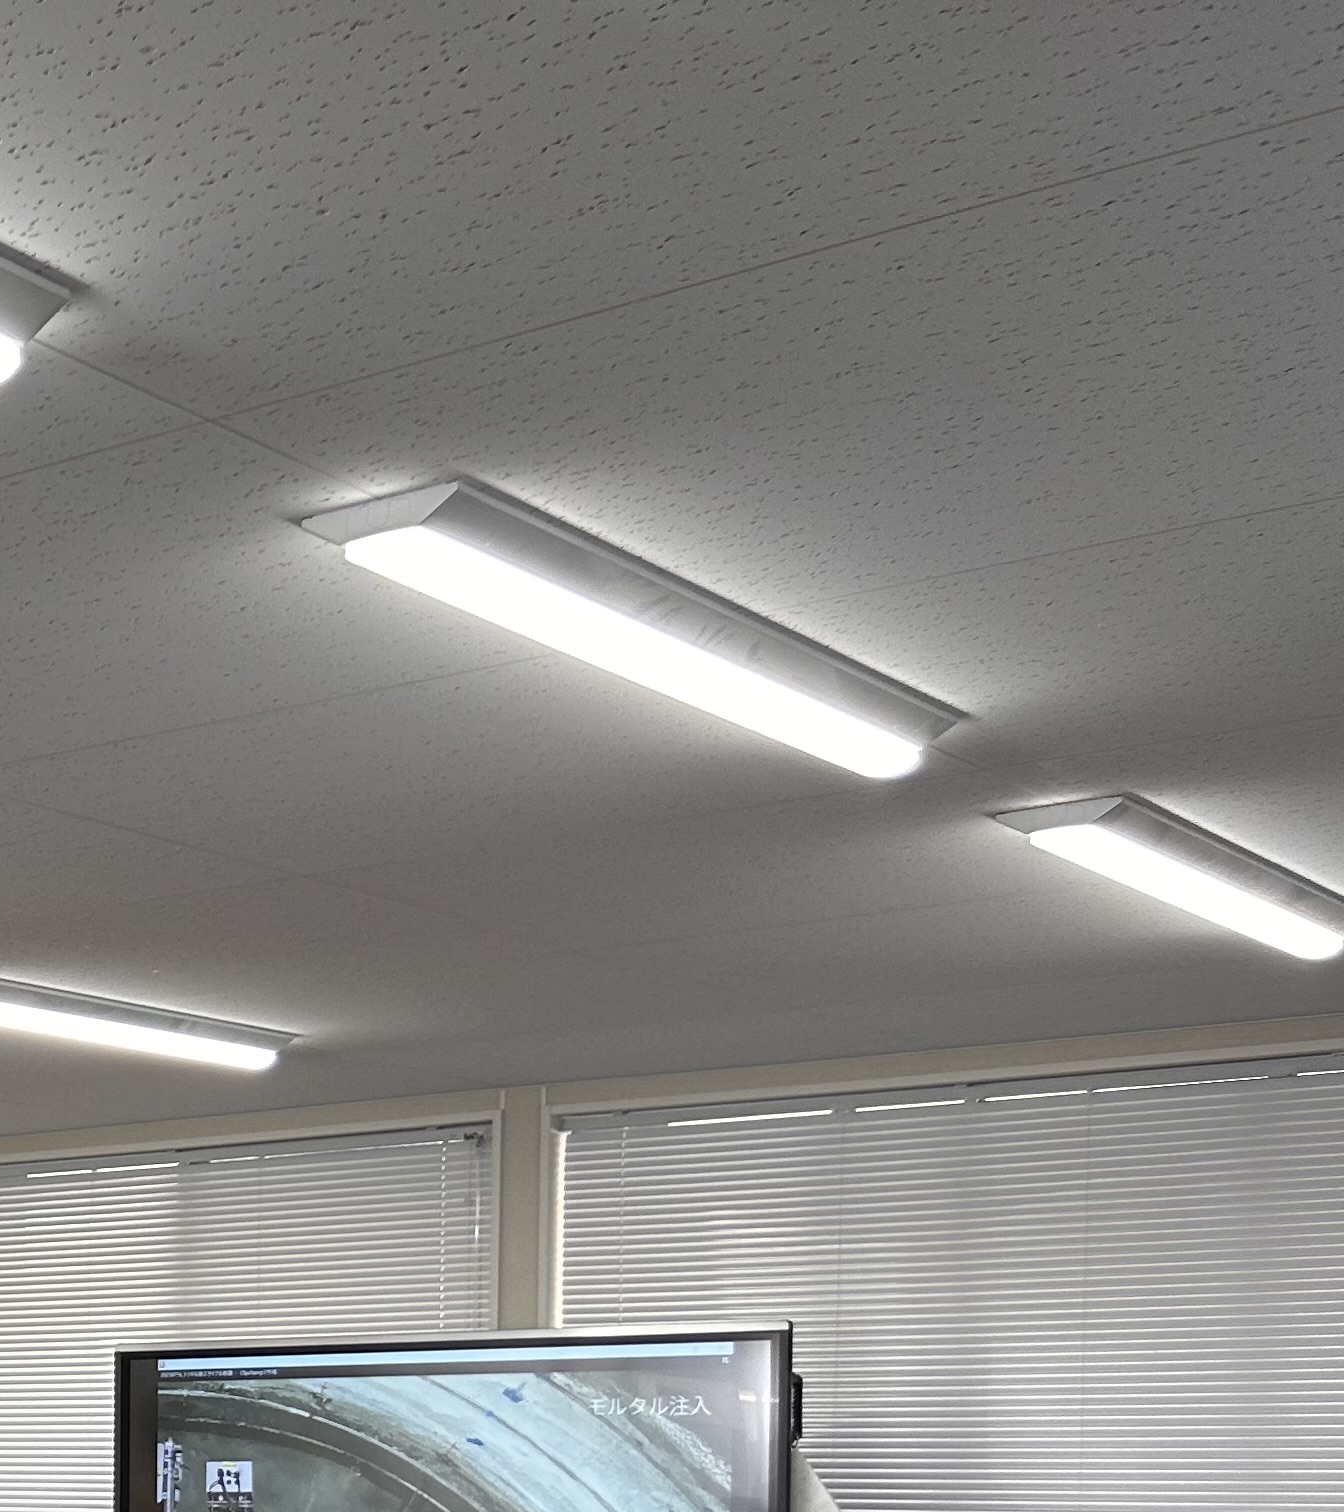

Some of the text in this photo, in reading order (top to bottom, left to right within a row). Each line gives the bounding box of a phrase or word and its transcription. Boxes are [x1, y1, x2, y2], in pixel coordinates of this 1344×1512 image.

[588, 1395, 712, 1416] モルタル注入
